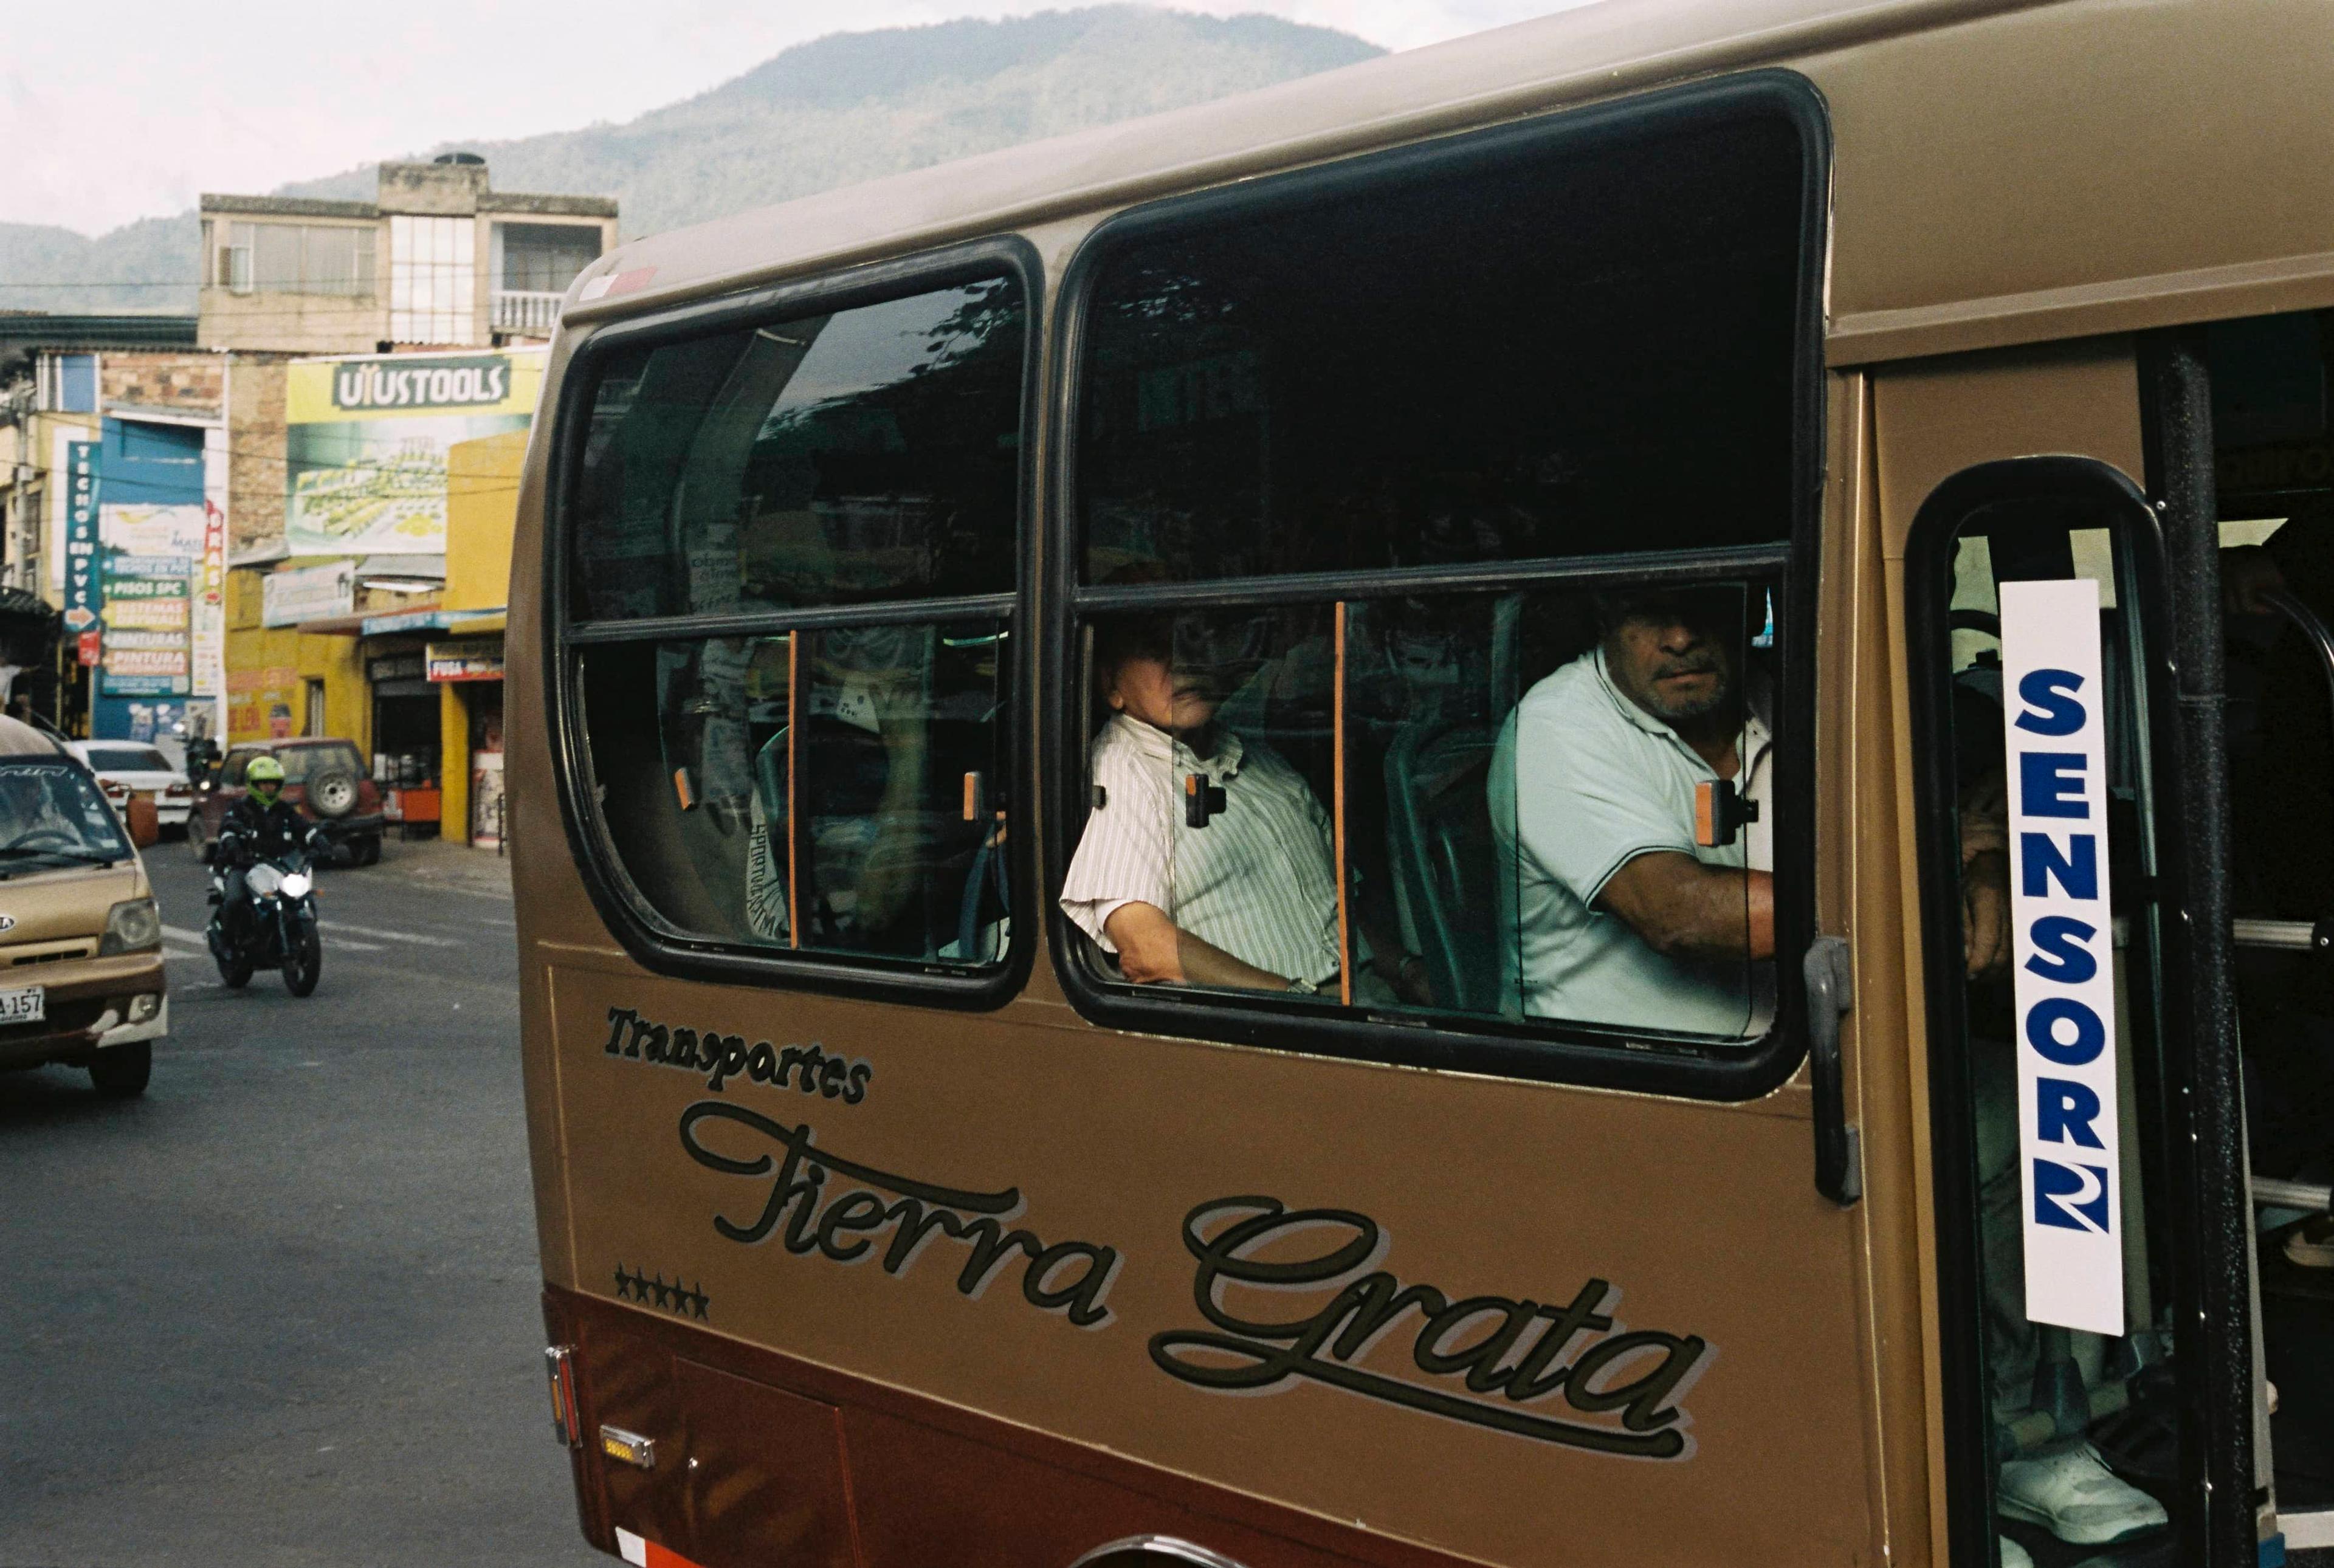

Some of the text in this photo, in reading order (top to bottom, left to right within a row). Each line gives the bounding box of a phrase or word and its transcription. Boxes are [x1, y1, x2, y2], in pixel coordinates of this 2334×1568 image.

[605, 1006, 872, 1104] Transportes
[2014, 668, 2105, 1150] SENSOR
[679, 1101, 1709, 1463] Tierra Grata
